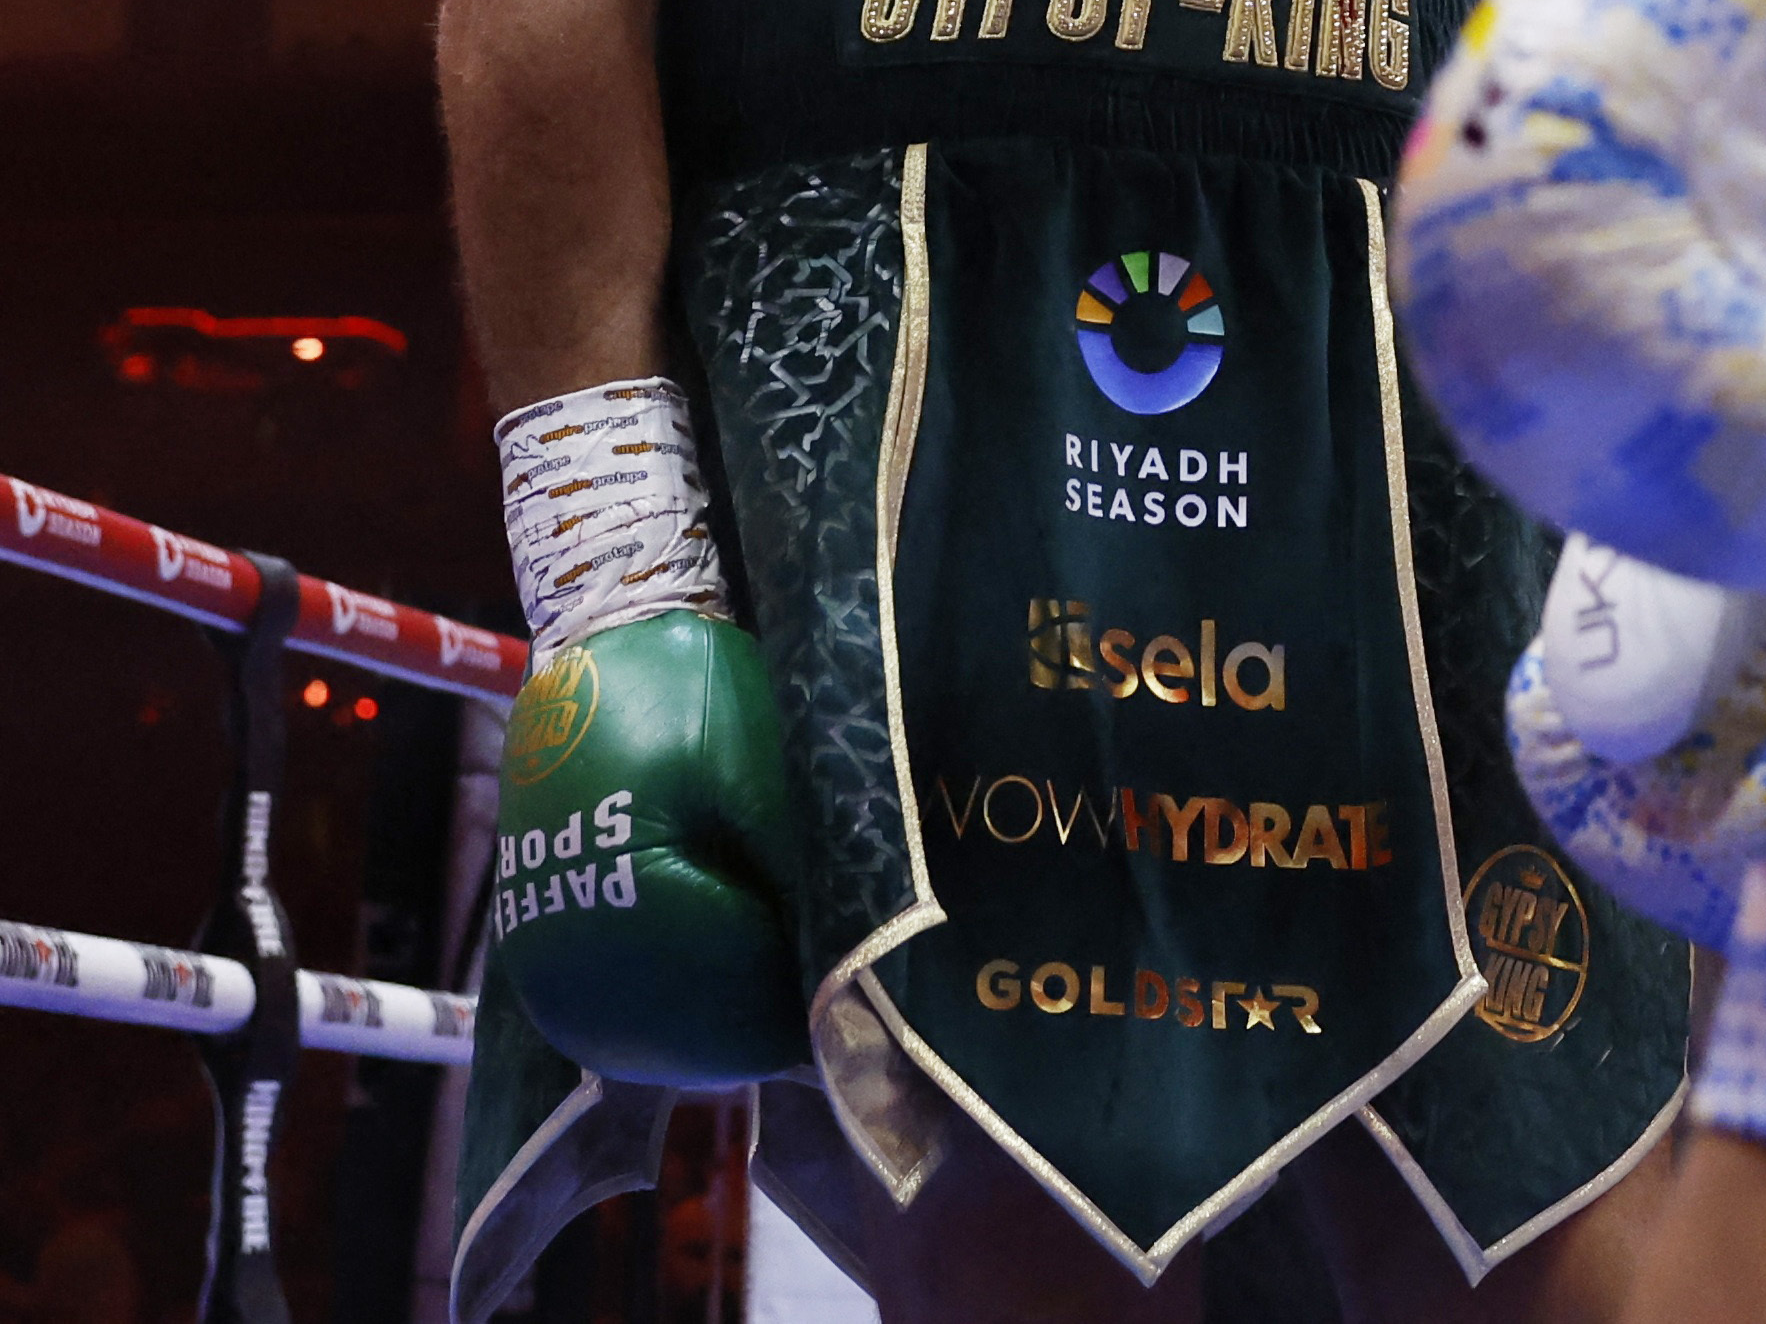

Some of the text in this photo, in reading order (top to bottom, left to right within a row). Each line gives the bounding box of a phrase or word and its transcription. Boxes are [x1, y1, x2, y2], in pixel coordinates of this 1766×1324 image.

[1064, 432, 1249, 486] RIYADH
[1064, 476, 1249, 529] SEASON
[1099, 618, 1286, 711] sela
[496, 789, 632, 884] SPOR
[1478, 881, 1569, 957] GYPSY
[1482, 952, 1550, 1022] KING
